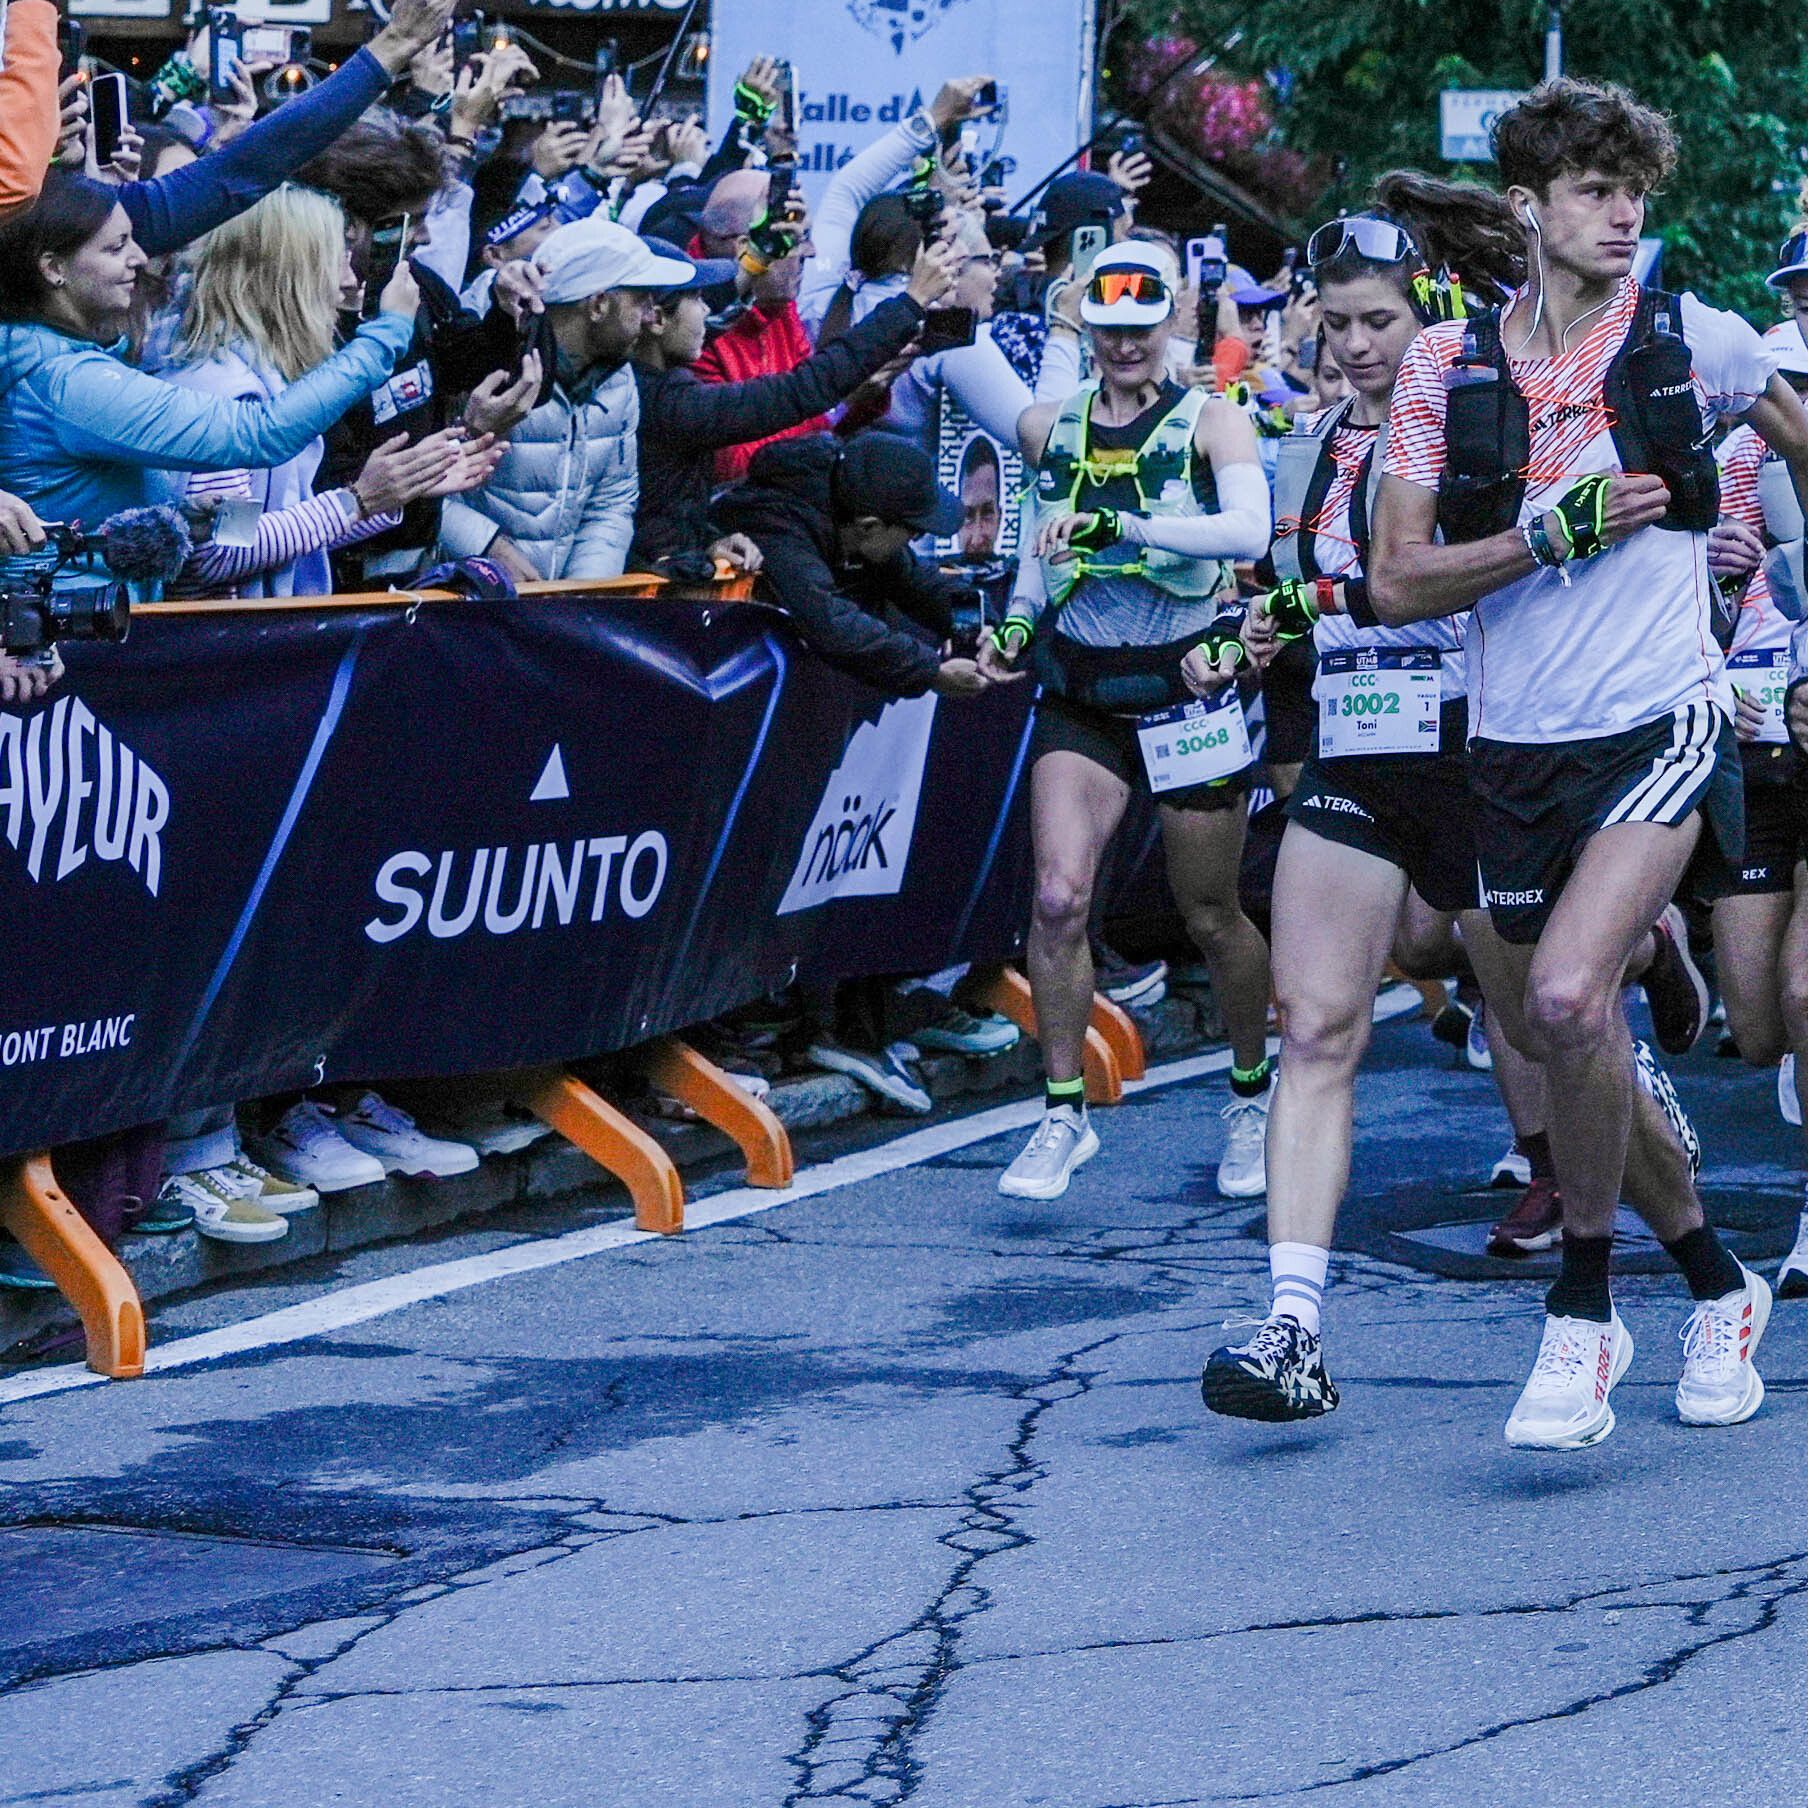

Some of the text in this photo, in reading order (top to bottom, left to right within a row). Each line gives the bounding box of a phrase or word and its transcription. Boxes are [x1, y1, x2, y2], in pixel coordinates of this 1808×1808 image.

[800, 90, 872, 123] alle
[1573, 481, 1597, 508] LEKI
[1351, 674, 1376, 687] CCC
[1341, 692, 1400, 717] 3002
[1424, 701, 1430, 712] 1
[1759, 686, 1786, 705] 30
[1183, 718, 1208, 732] CCC
[1356, 719, 1377, 730] Toni
[1175, 728, 1230, 756] 3068
[0, 694, 170, 898] AYEUR
[1741, 867, 1768, 881] REX
[365, 829, 669, 944] SUUNTO
[1491, 888, 1544, 906] TERREX
[0, 1013, 136, 1067] ONT BLANC
